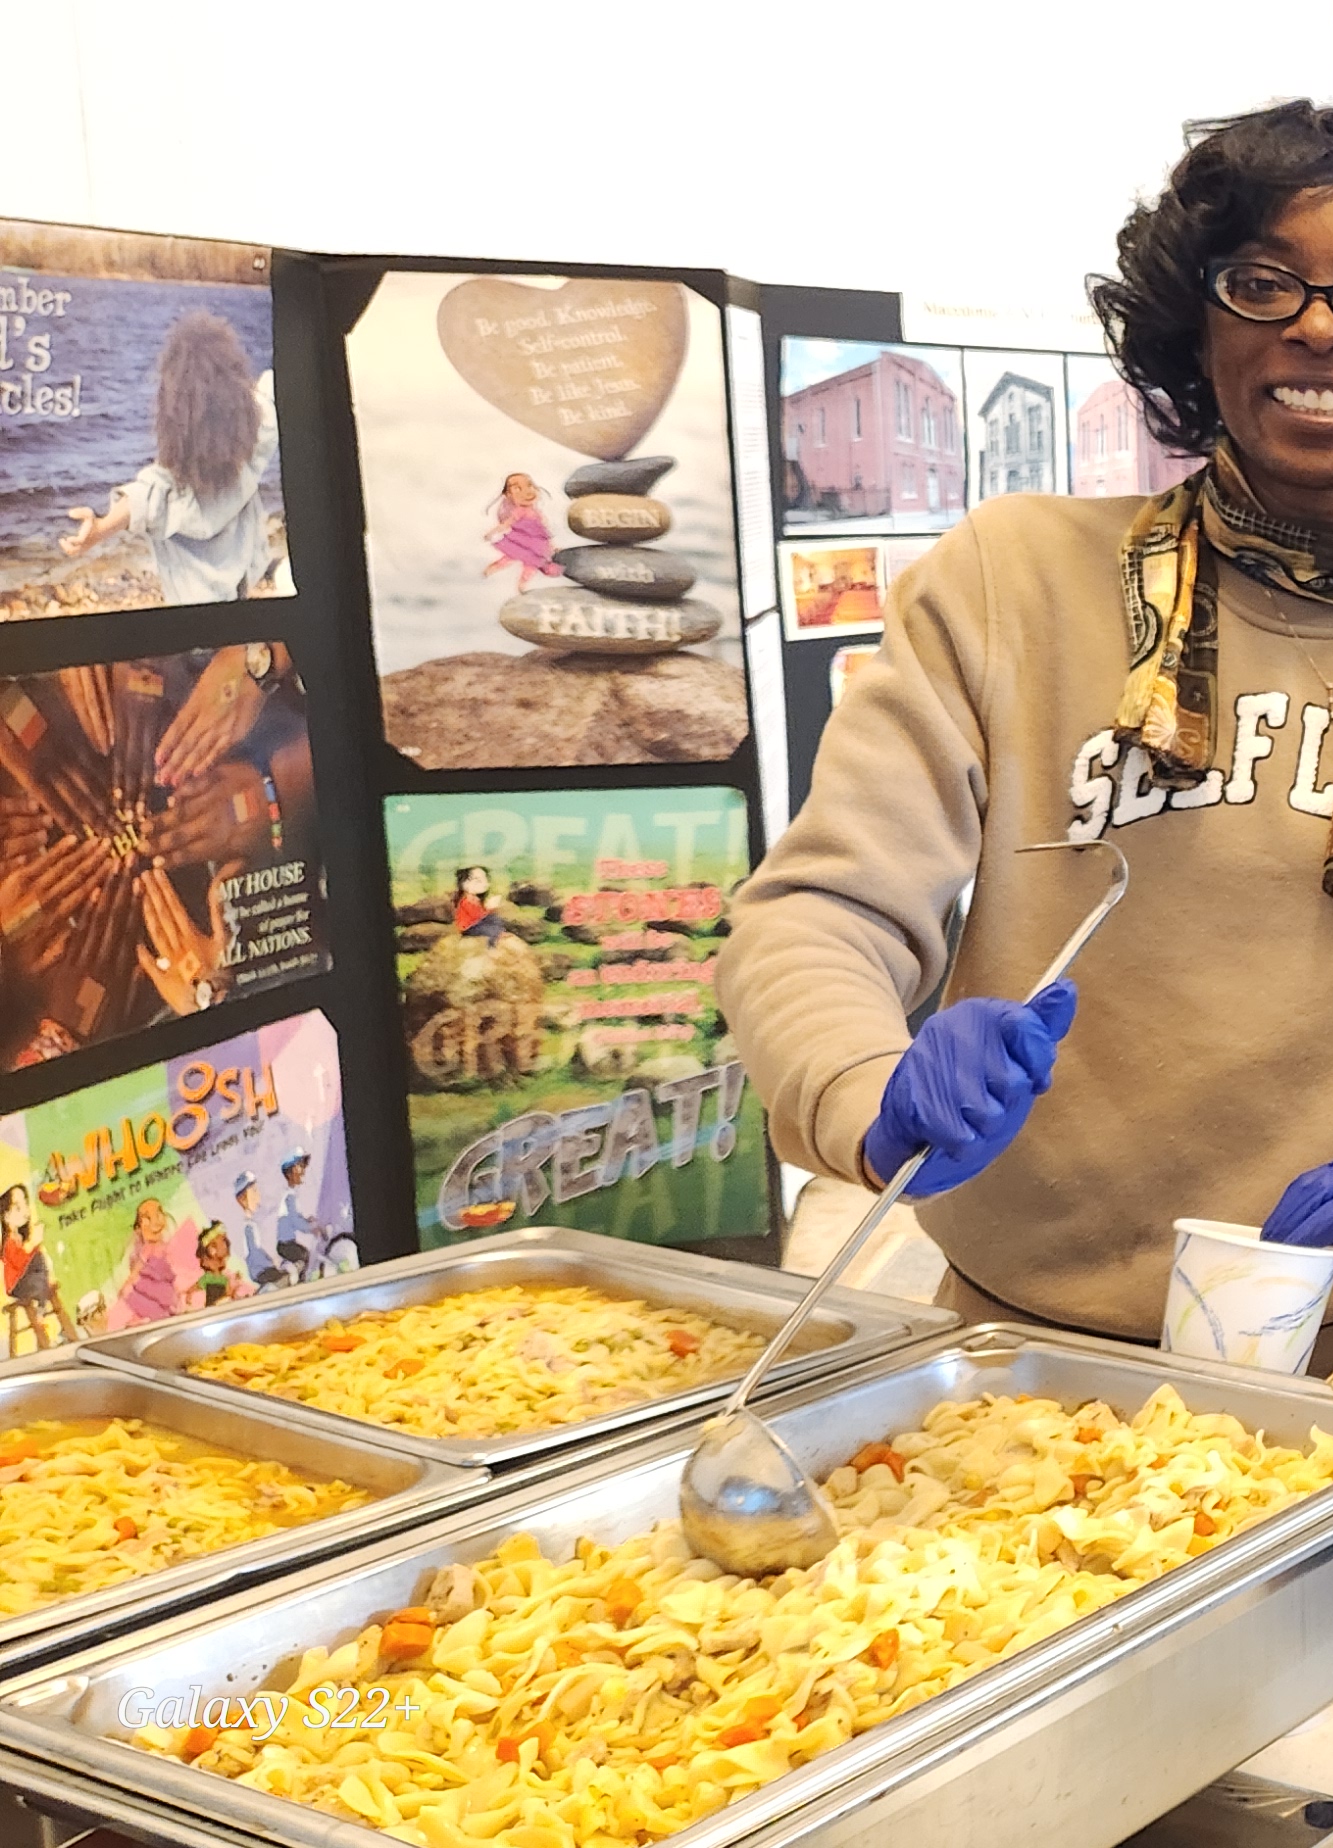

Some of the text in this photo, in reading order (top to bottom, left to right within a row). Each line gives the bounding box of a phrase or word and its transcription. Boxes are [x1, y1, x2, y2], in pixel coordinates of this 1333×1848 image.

[582, 508, 660, 528] BEGIN
[538, 603, 682, 642] FAITH!
[219, 861, 305, 902] MY HOUSE
[218, 942, 248, 970] ALL
[438, 1060, 746, 1229] GREAT!
